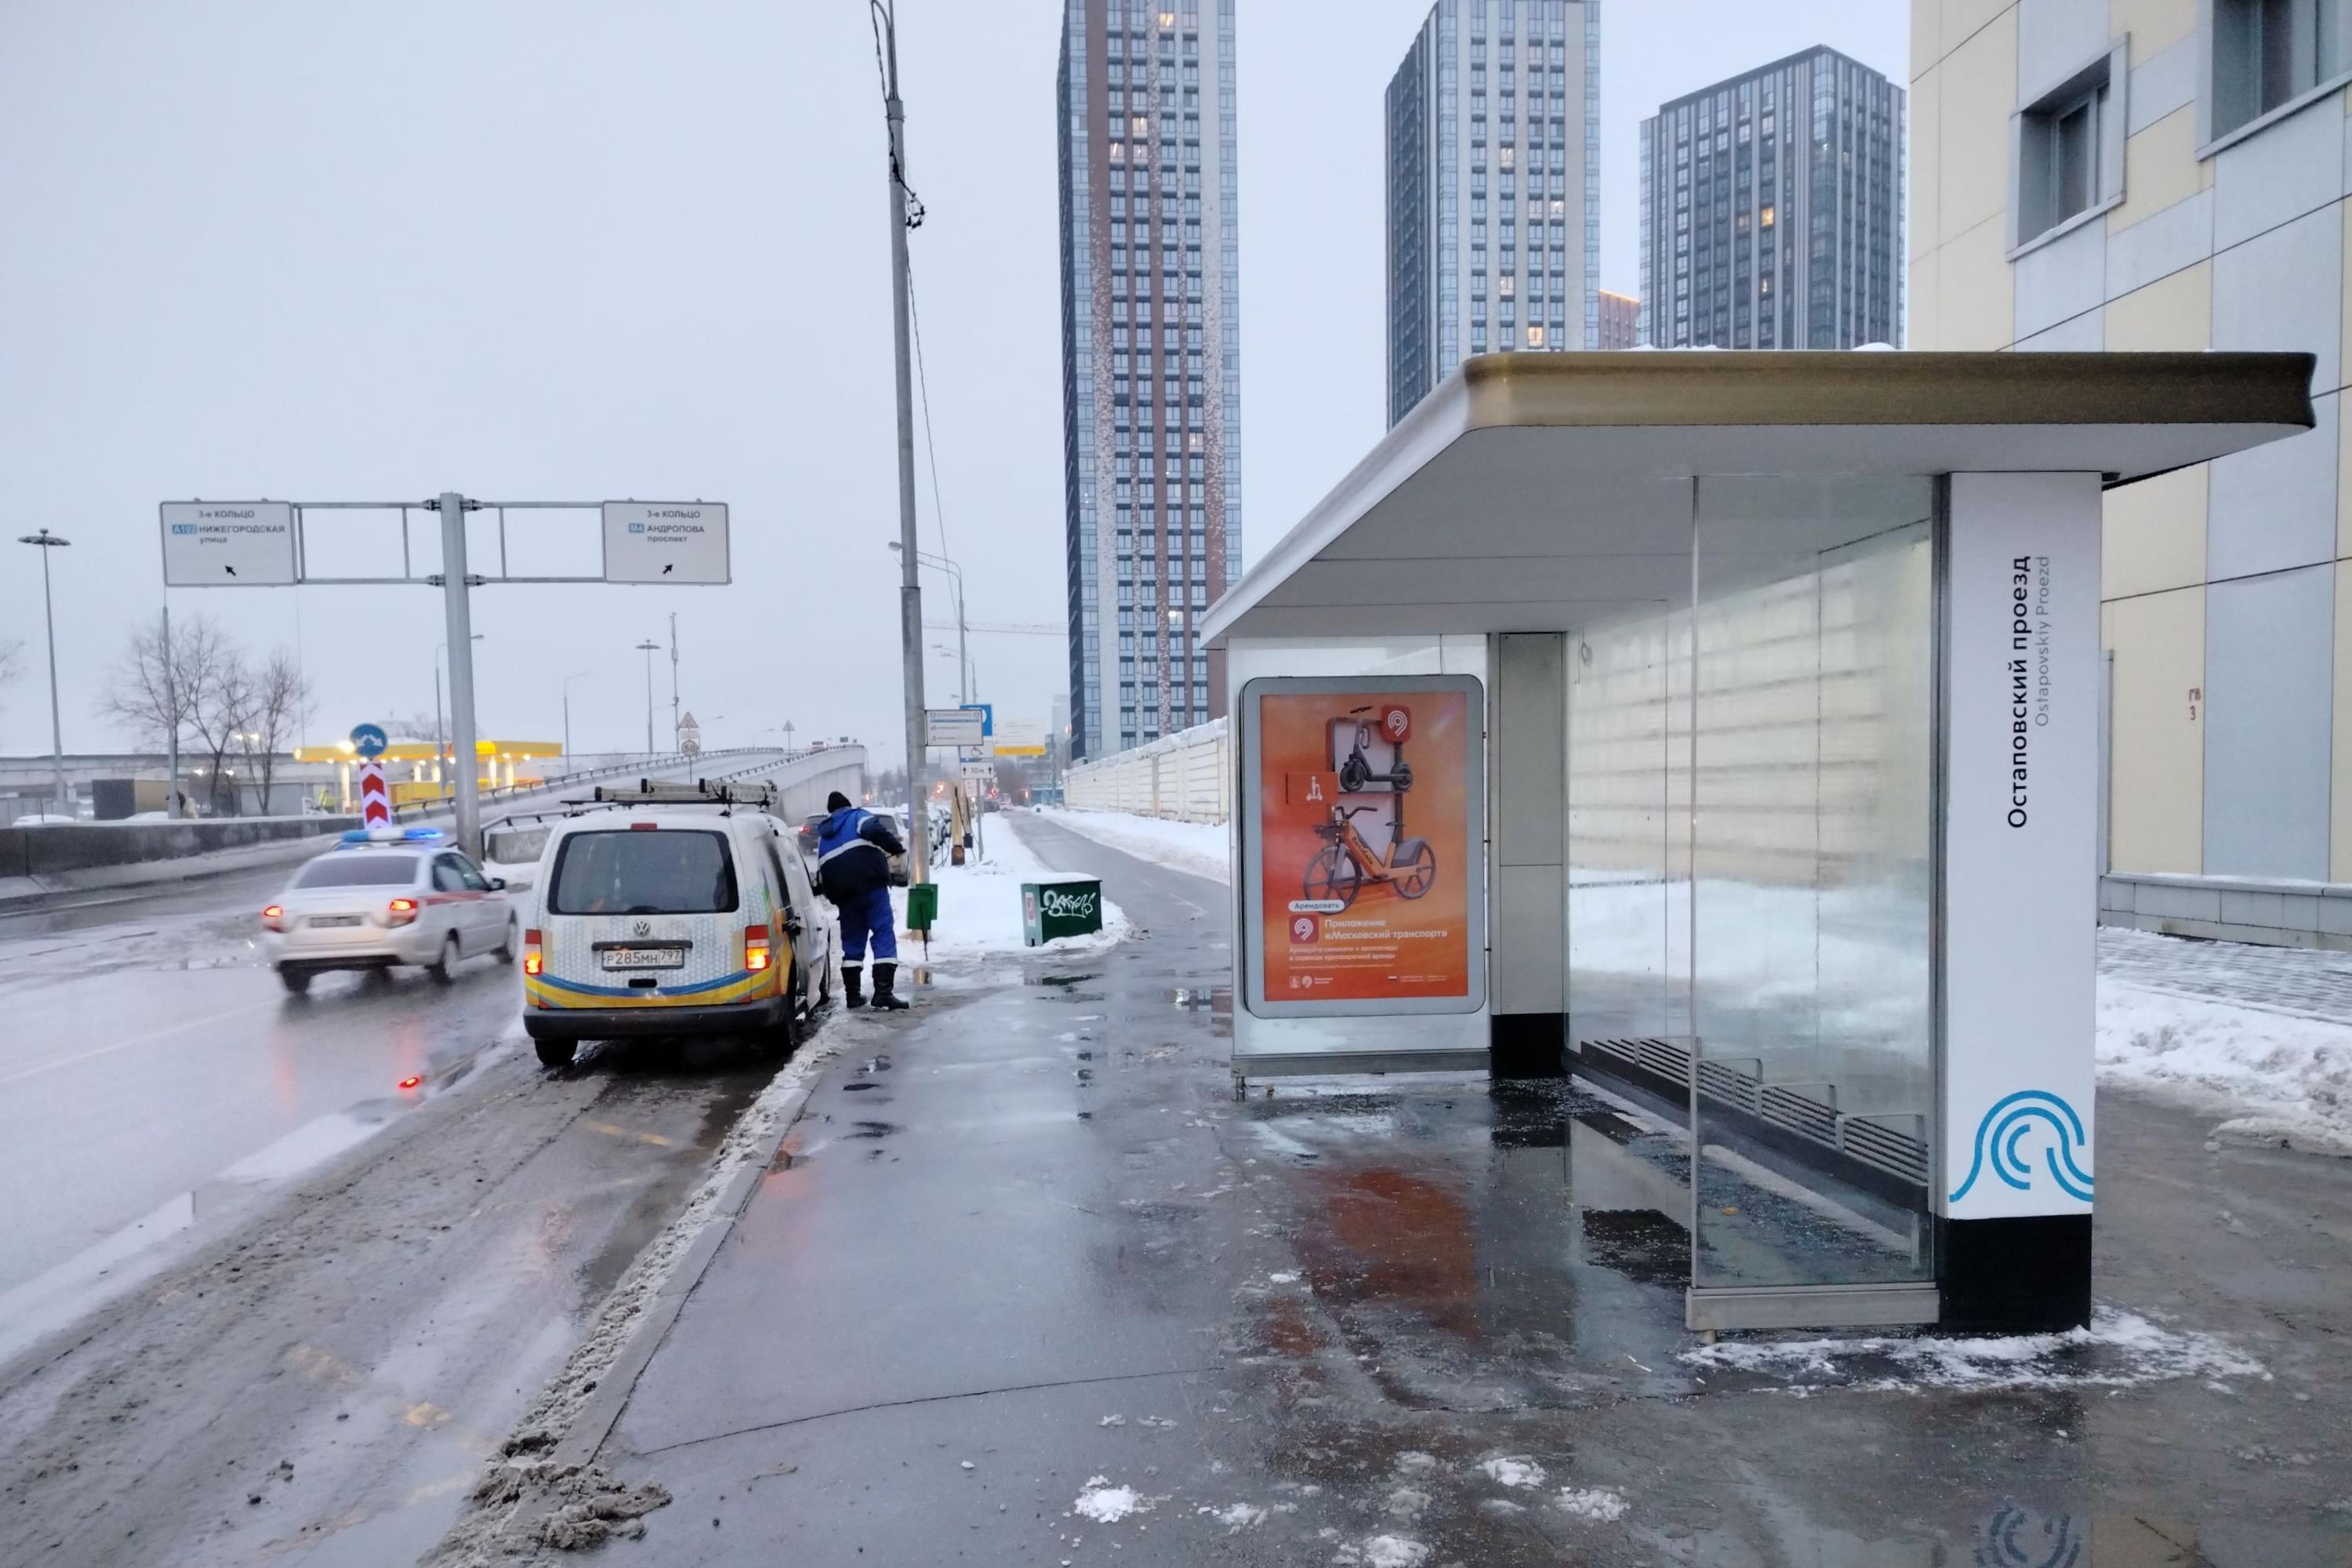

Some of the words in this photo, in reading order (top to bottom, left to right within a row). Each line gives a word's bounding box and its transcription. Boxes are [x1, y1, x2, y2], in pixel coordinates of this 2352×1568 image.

[215, 510, 255, 519] КОЛЬЦО
[662, 510, 701, 519] КОЛЬЦО
[199, 525, 285, 534] НИЖЕГОРОДСКАЯ
[2035, 556, 2049, 615] Proezd
[2013, 556, 2032, 650] проезд
[2035, 620, 2052, 727] Ostapovskiy
[2008, 659, 2027, 828] Остаповский
[1325, 919, 1386, 928] Приложение
[1325, 930, 1391, 940] «Московский
[1392, 931, 1447, 940] транспорт»
